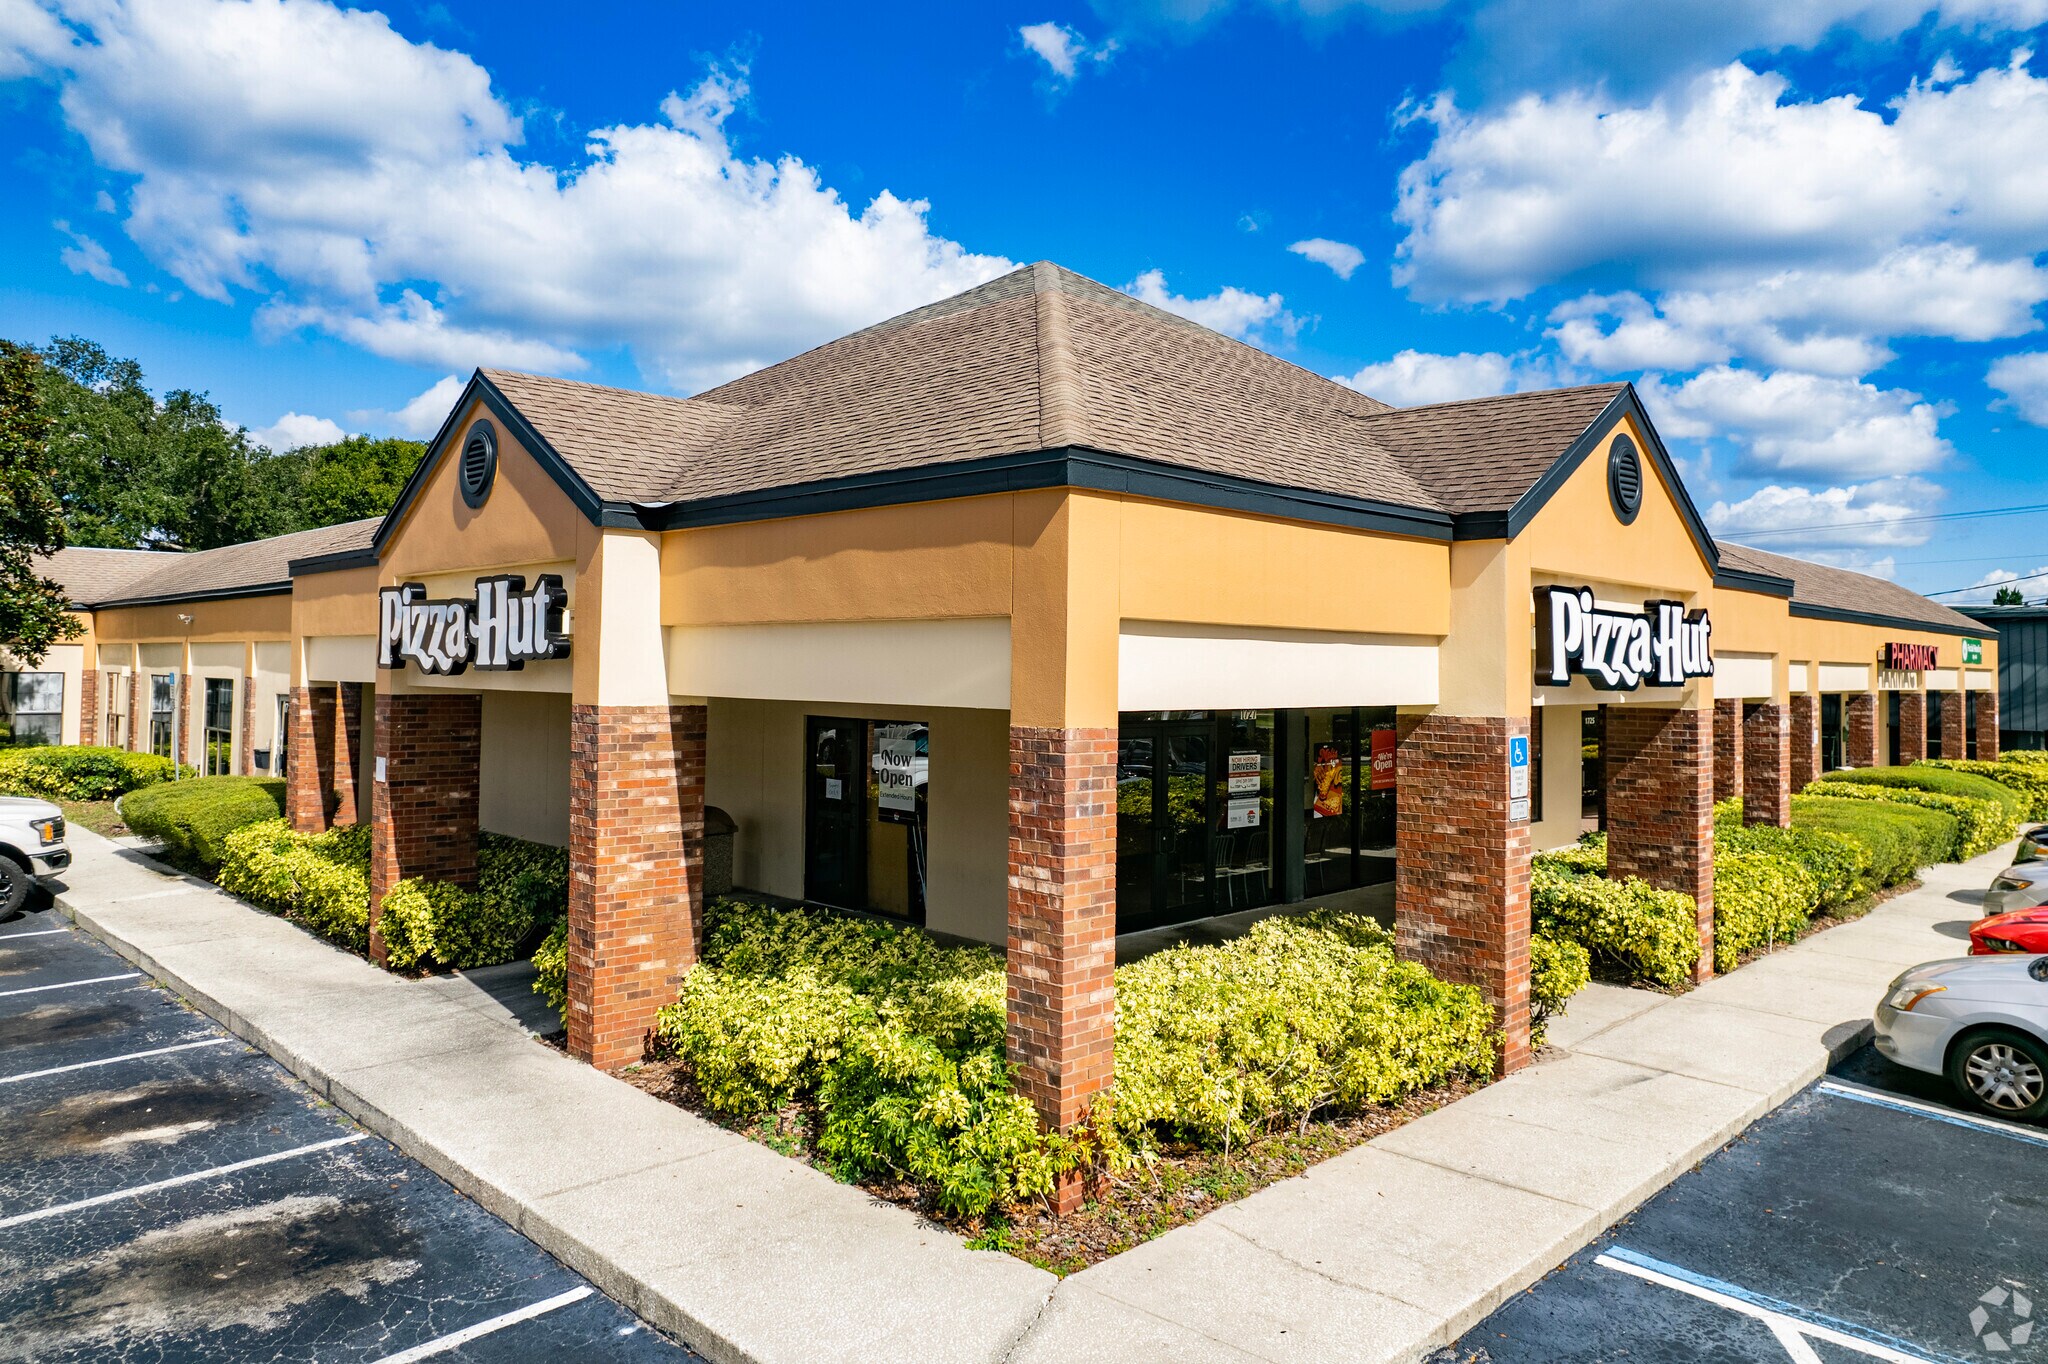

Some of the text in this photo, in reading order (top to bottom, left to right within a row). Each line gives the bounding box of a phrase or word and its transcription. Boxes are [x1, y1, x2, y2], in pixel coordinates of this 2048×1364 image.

[379, 579, 551, 671] Pizza Hut
[1550, 590, 1711, 686] Pizza Hut
[1891, 642, 1939, 671] PHARMACY
[880, 749, 912, 767] Now
[1377, 752, 1393, 760] We're
[1232, 763, 1258, 771] DRIVERS
[1373, 760, 1393, 772] Open
[880, 768, 913, 788] Open
[880, 791, 913, 801] Extended Hours
